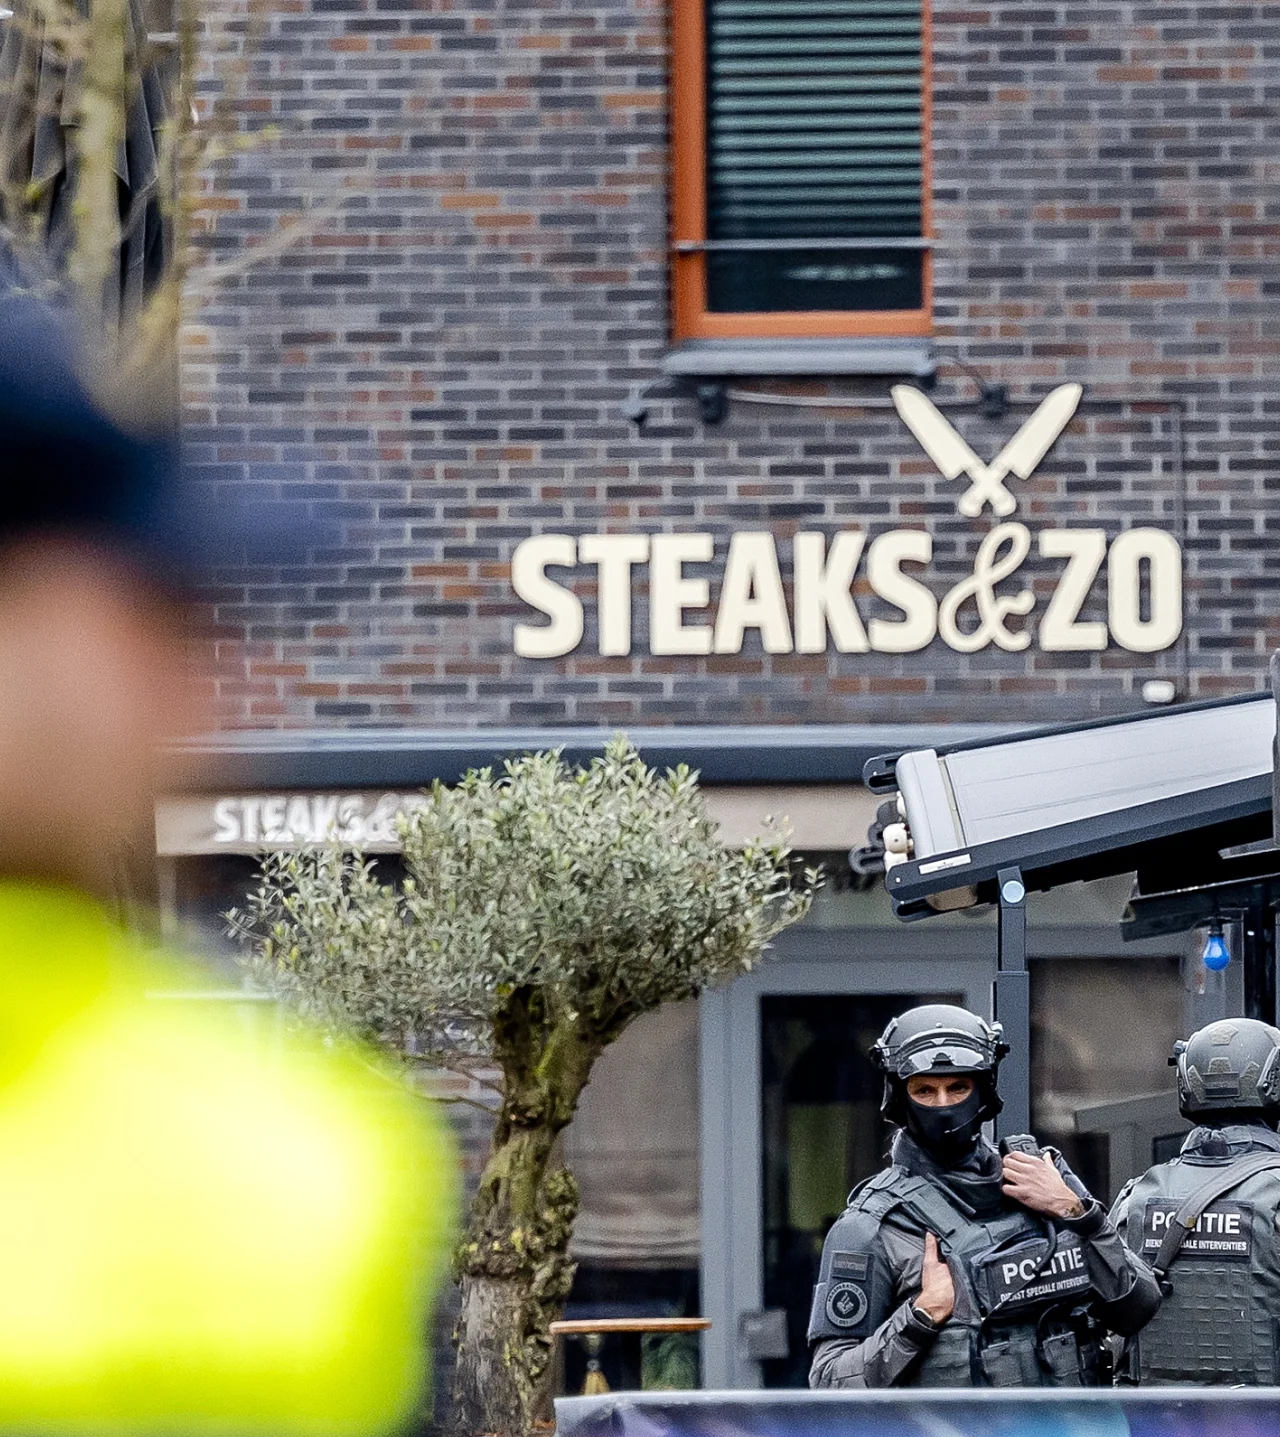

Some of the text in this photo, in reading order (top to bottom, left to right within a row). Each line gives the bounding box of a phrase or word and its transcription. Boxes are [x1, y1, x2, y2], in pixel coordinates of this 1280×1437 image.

[1145, 1238, 1163, 1248] DIENS
[1198, 1240, 1247, 1251] INTERVENTIES
[1025, 1282, 1057, 1299] SPECIALE
